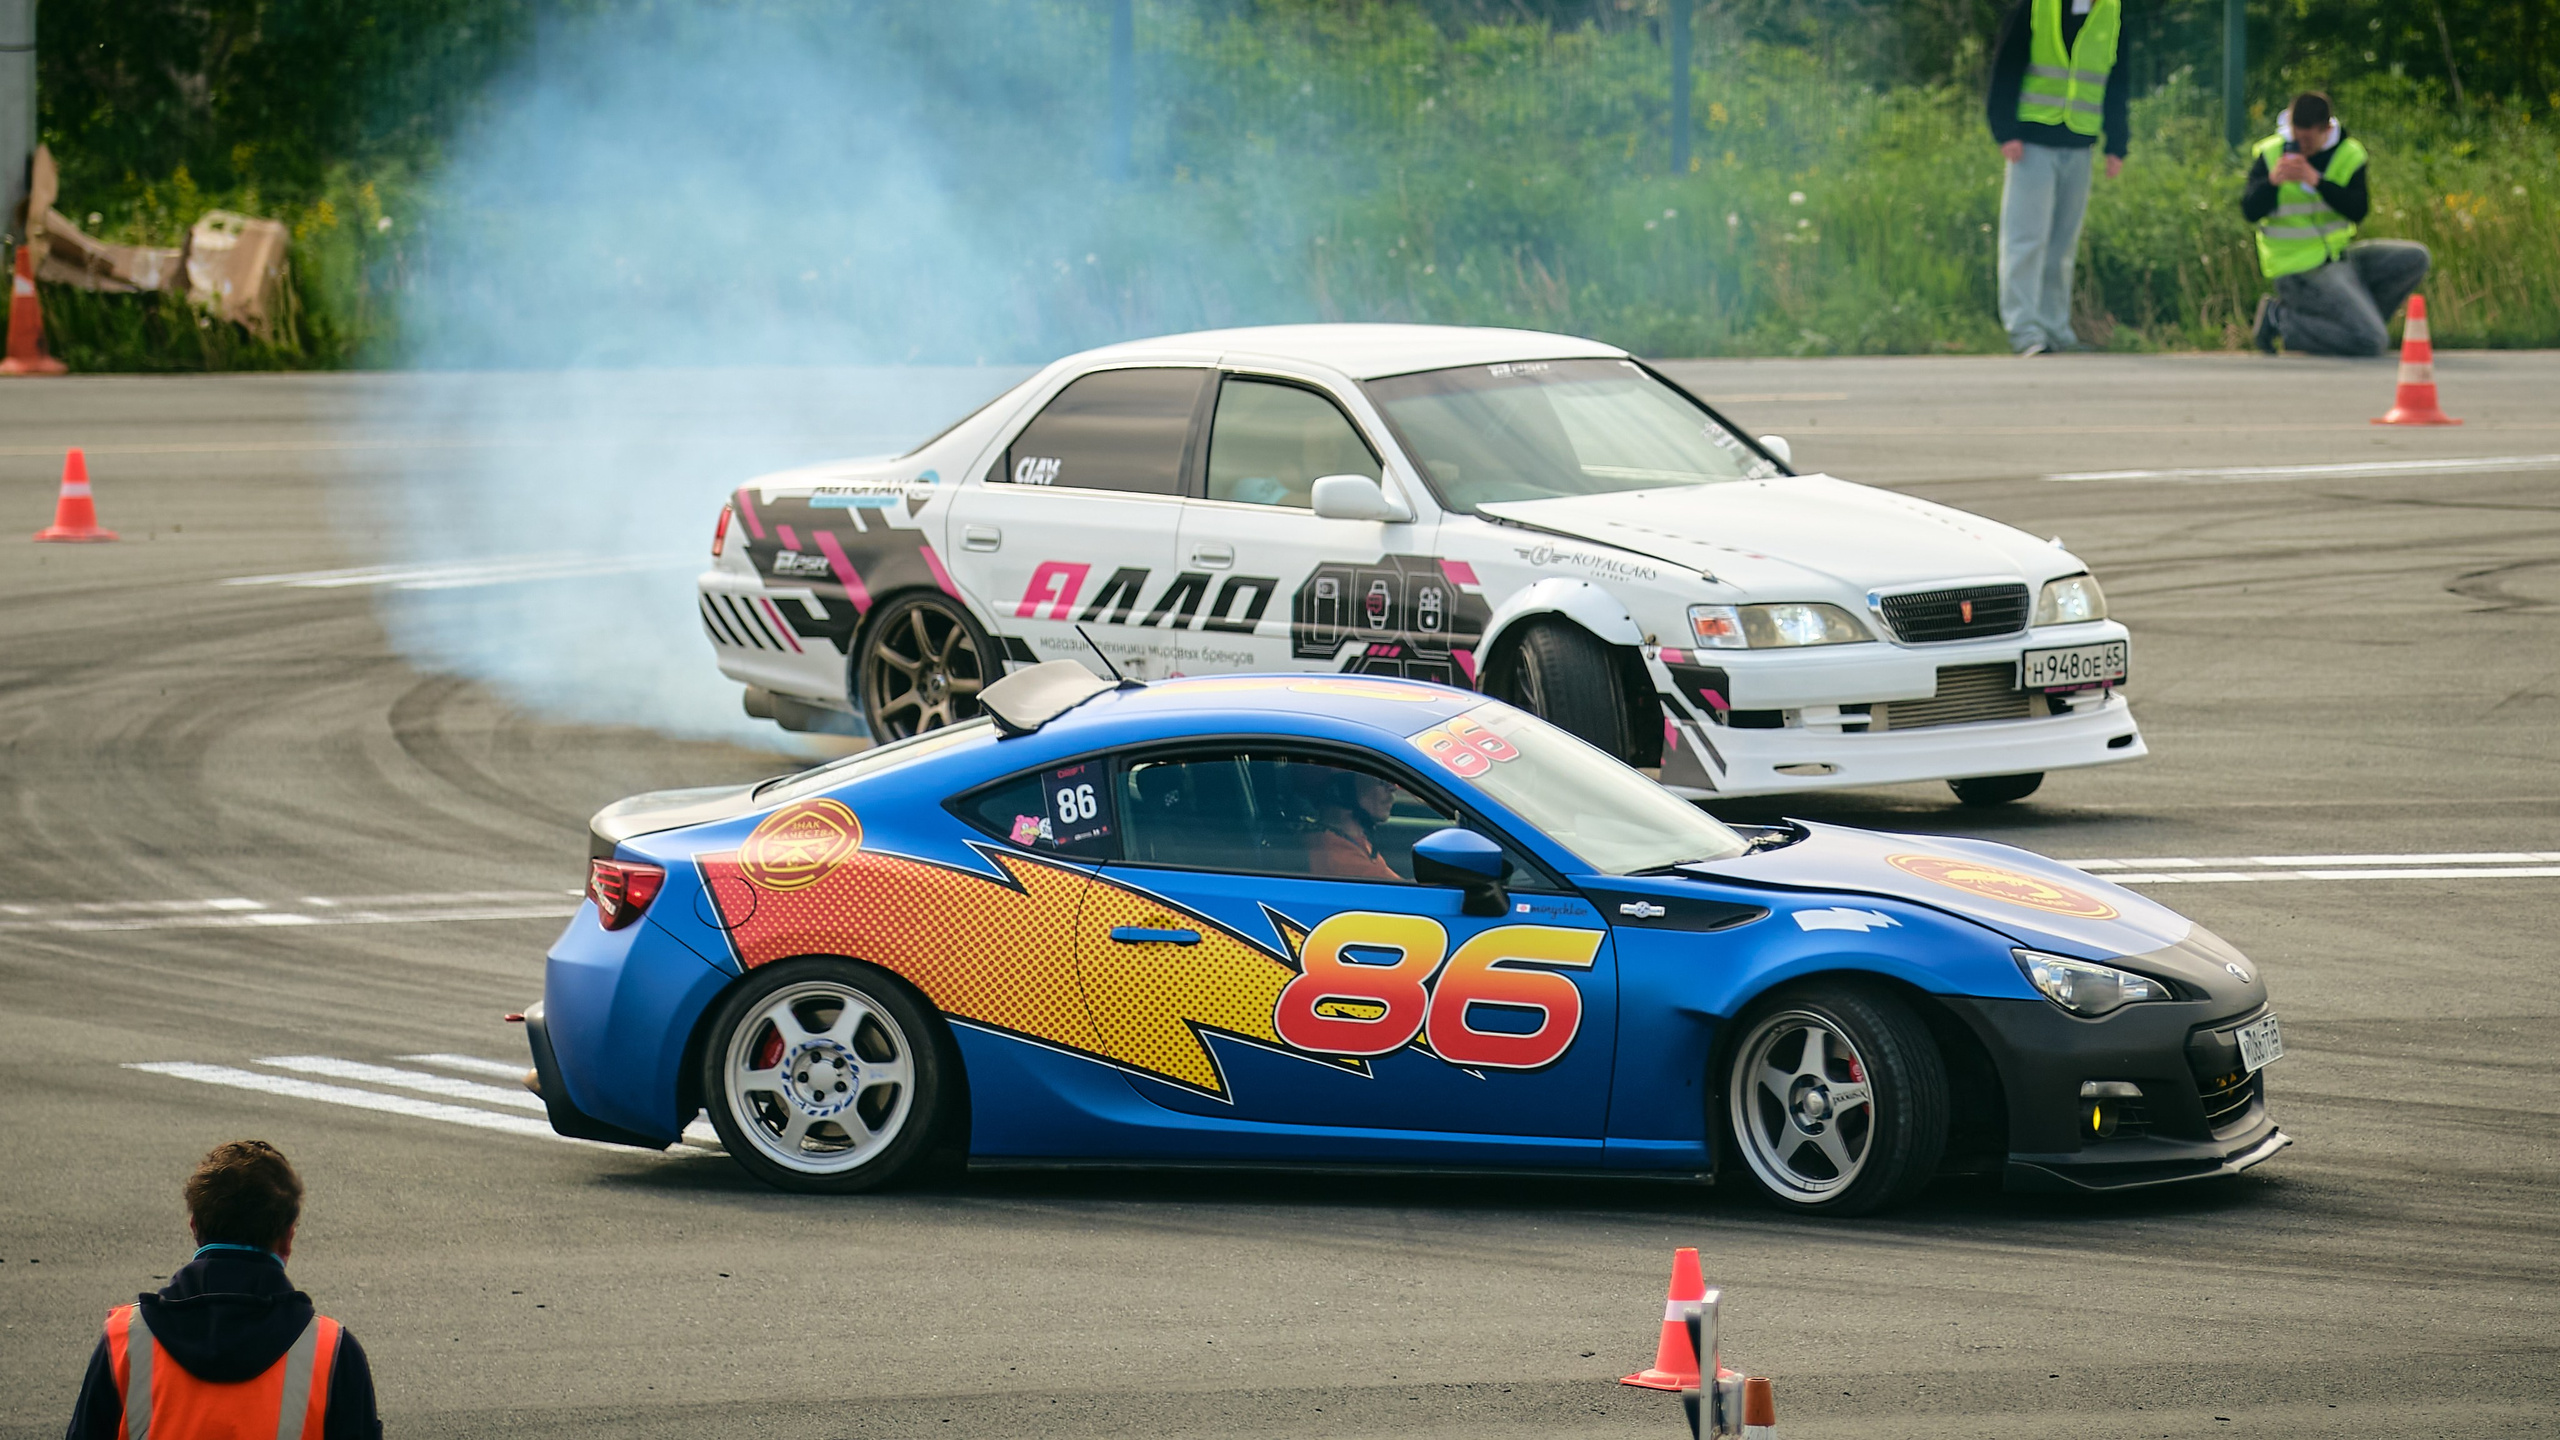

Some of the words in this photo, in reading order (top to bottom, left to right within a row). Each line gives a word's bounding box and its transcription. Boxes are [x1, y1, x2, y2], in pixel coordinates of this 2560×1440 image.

[1014, 456, 1062, 486] CLAY
[2105, 646, 2120, 668] 65
[1414, 715, 1520, 779] 86
[1056, 783, 1098, 824] 86
[1273, 910, 1607, 1069] 86
